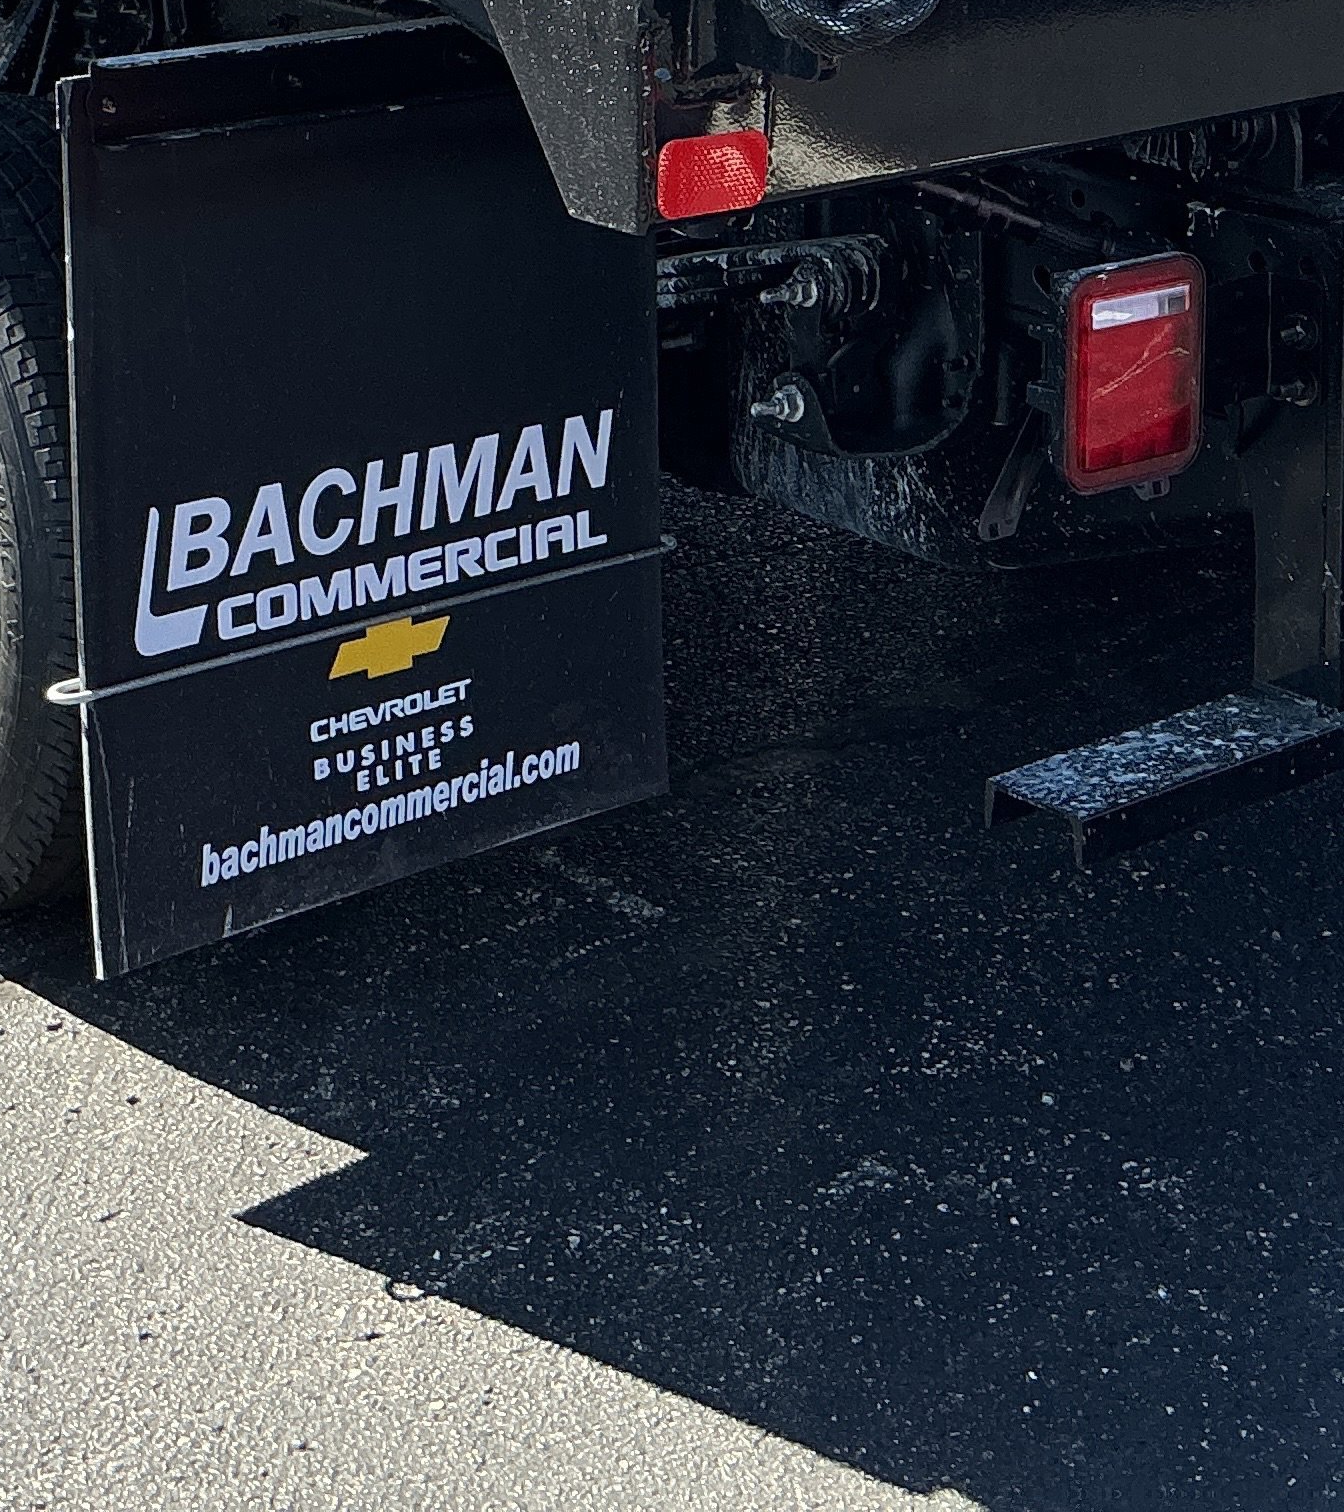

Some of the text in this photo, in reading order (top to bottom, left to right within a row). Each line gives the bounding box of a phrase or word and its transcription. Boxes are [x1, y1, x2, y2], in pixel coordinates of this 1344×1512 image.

[167, 409, 613, 591] BACHMAN
[217, 510, 607, 640] COMMERCIAL
[310, 679, 472, 742] CHEVROLET
[314, 714, 474, 781] BUSINESS
[201, 741, 580, 887] bachmancommercial.com
[357, 748, 442, 792] ELITE
